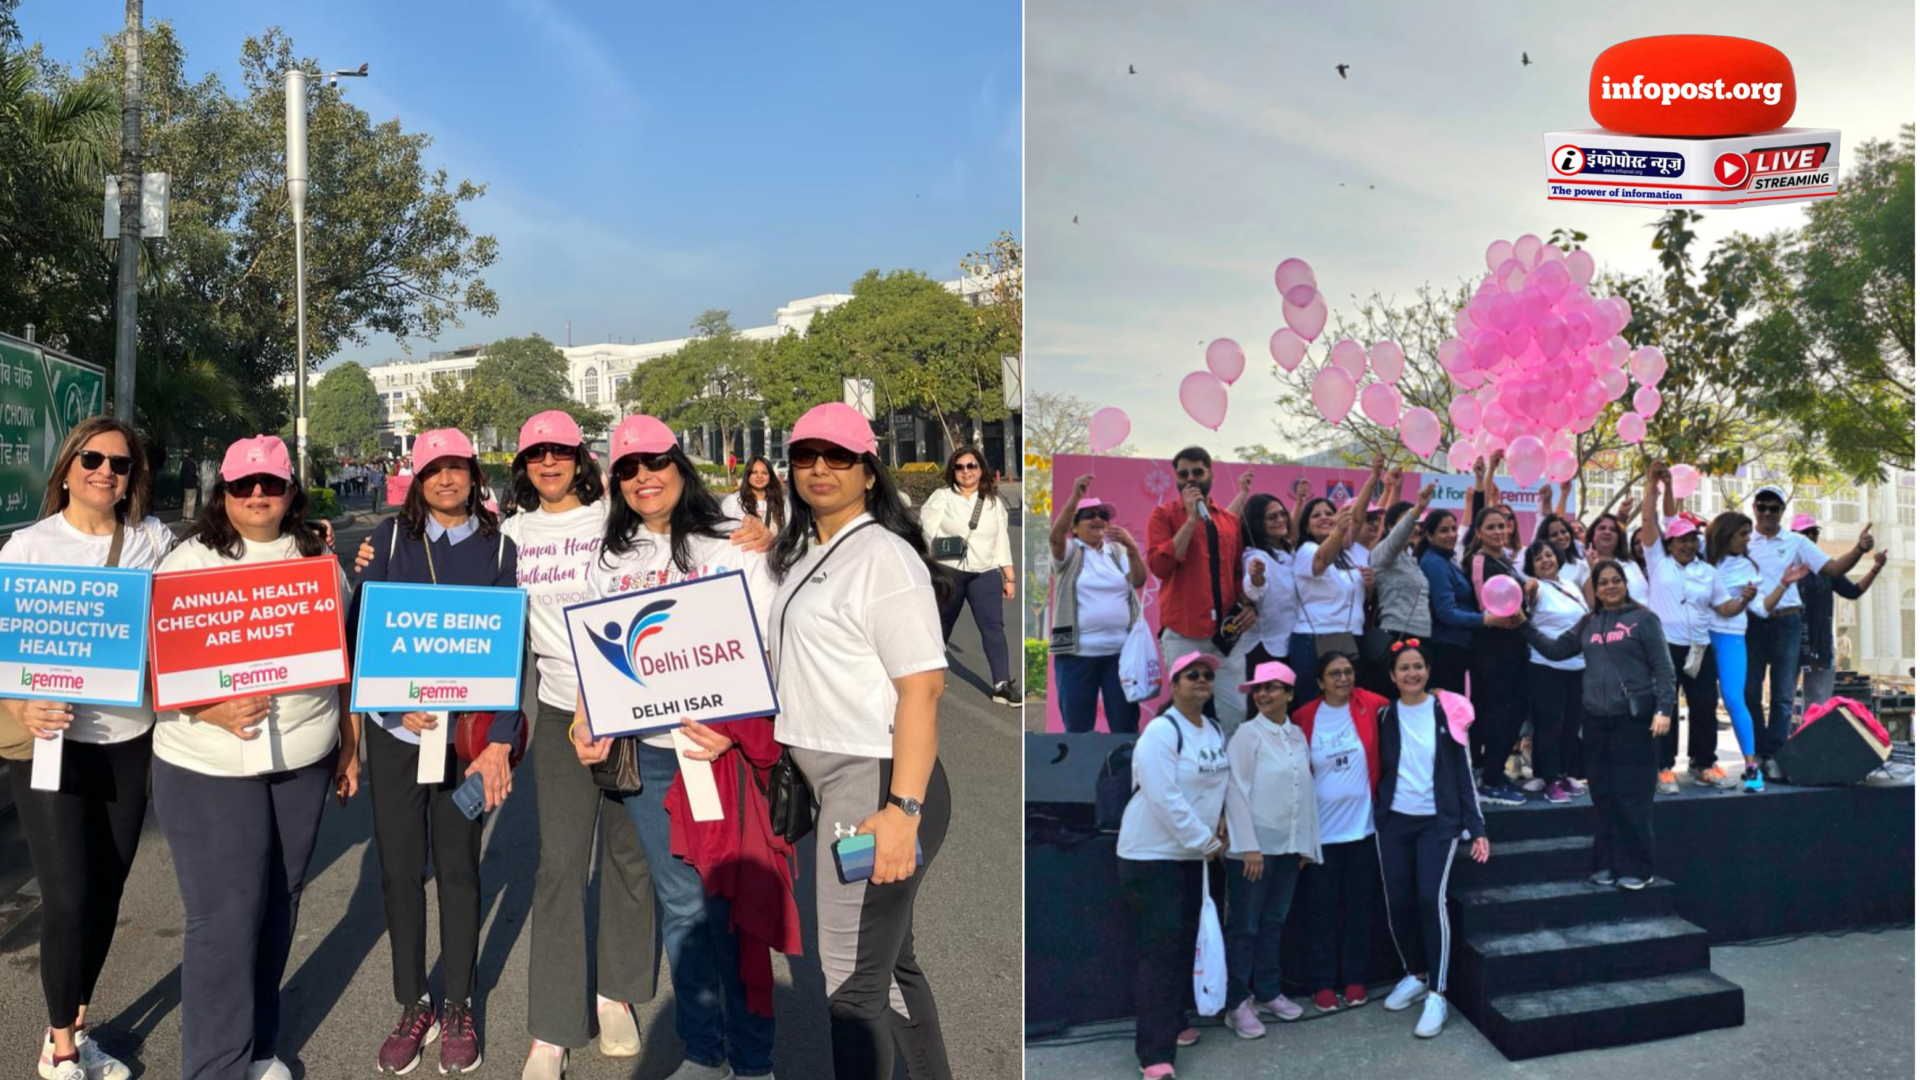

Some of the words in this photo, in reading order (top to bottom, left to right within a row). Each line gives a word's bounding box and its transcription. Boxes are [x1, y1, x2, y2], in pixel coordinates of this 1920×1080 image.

[5, 403, 36, 428] CHOWK
[563, 537, 602, 556] Healt
[4, 577, 11, 592] I
[14, 578, 76, 595] STAND
[81, 581, 119, 598] FOR
[171, 590, 248, 611] ANNUAL
[252, 581, 319, 601] HEALTH
[14, 597, 105, 617] WOMEN'S
[157, 609, 245, 632] CHECKUP
[249, 601, 310, 621] ABOVE
[314, 598, 335, 612] 40
[0, 617, 130, 639] EPRODUCTIVE
[385, 611, 438, 629] LOVE
[443, 613, 502, 630] BEING
[205, 630, 242, 647] ARE
[246, 623, 295, 642] MUST
[391, 637, 407, 653] A
[412, 637, 492, 655] WOMEN
[19, 638, 92, 658] HEALTH
[640, 649, 689, 676] Delhi
[692, 639, 745, 667] ISAR
[632, 700, 680, 720] DELHI
[684, 694, 724, 712] ISAR
